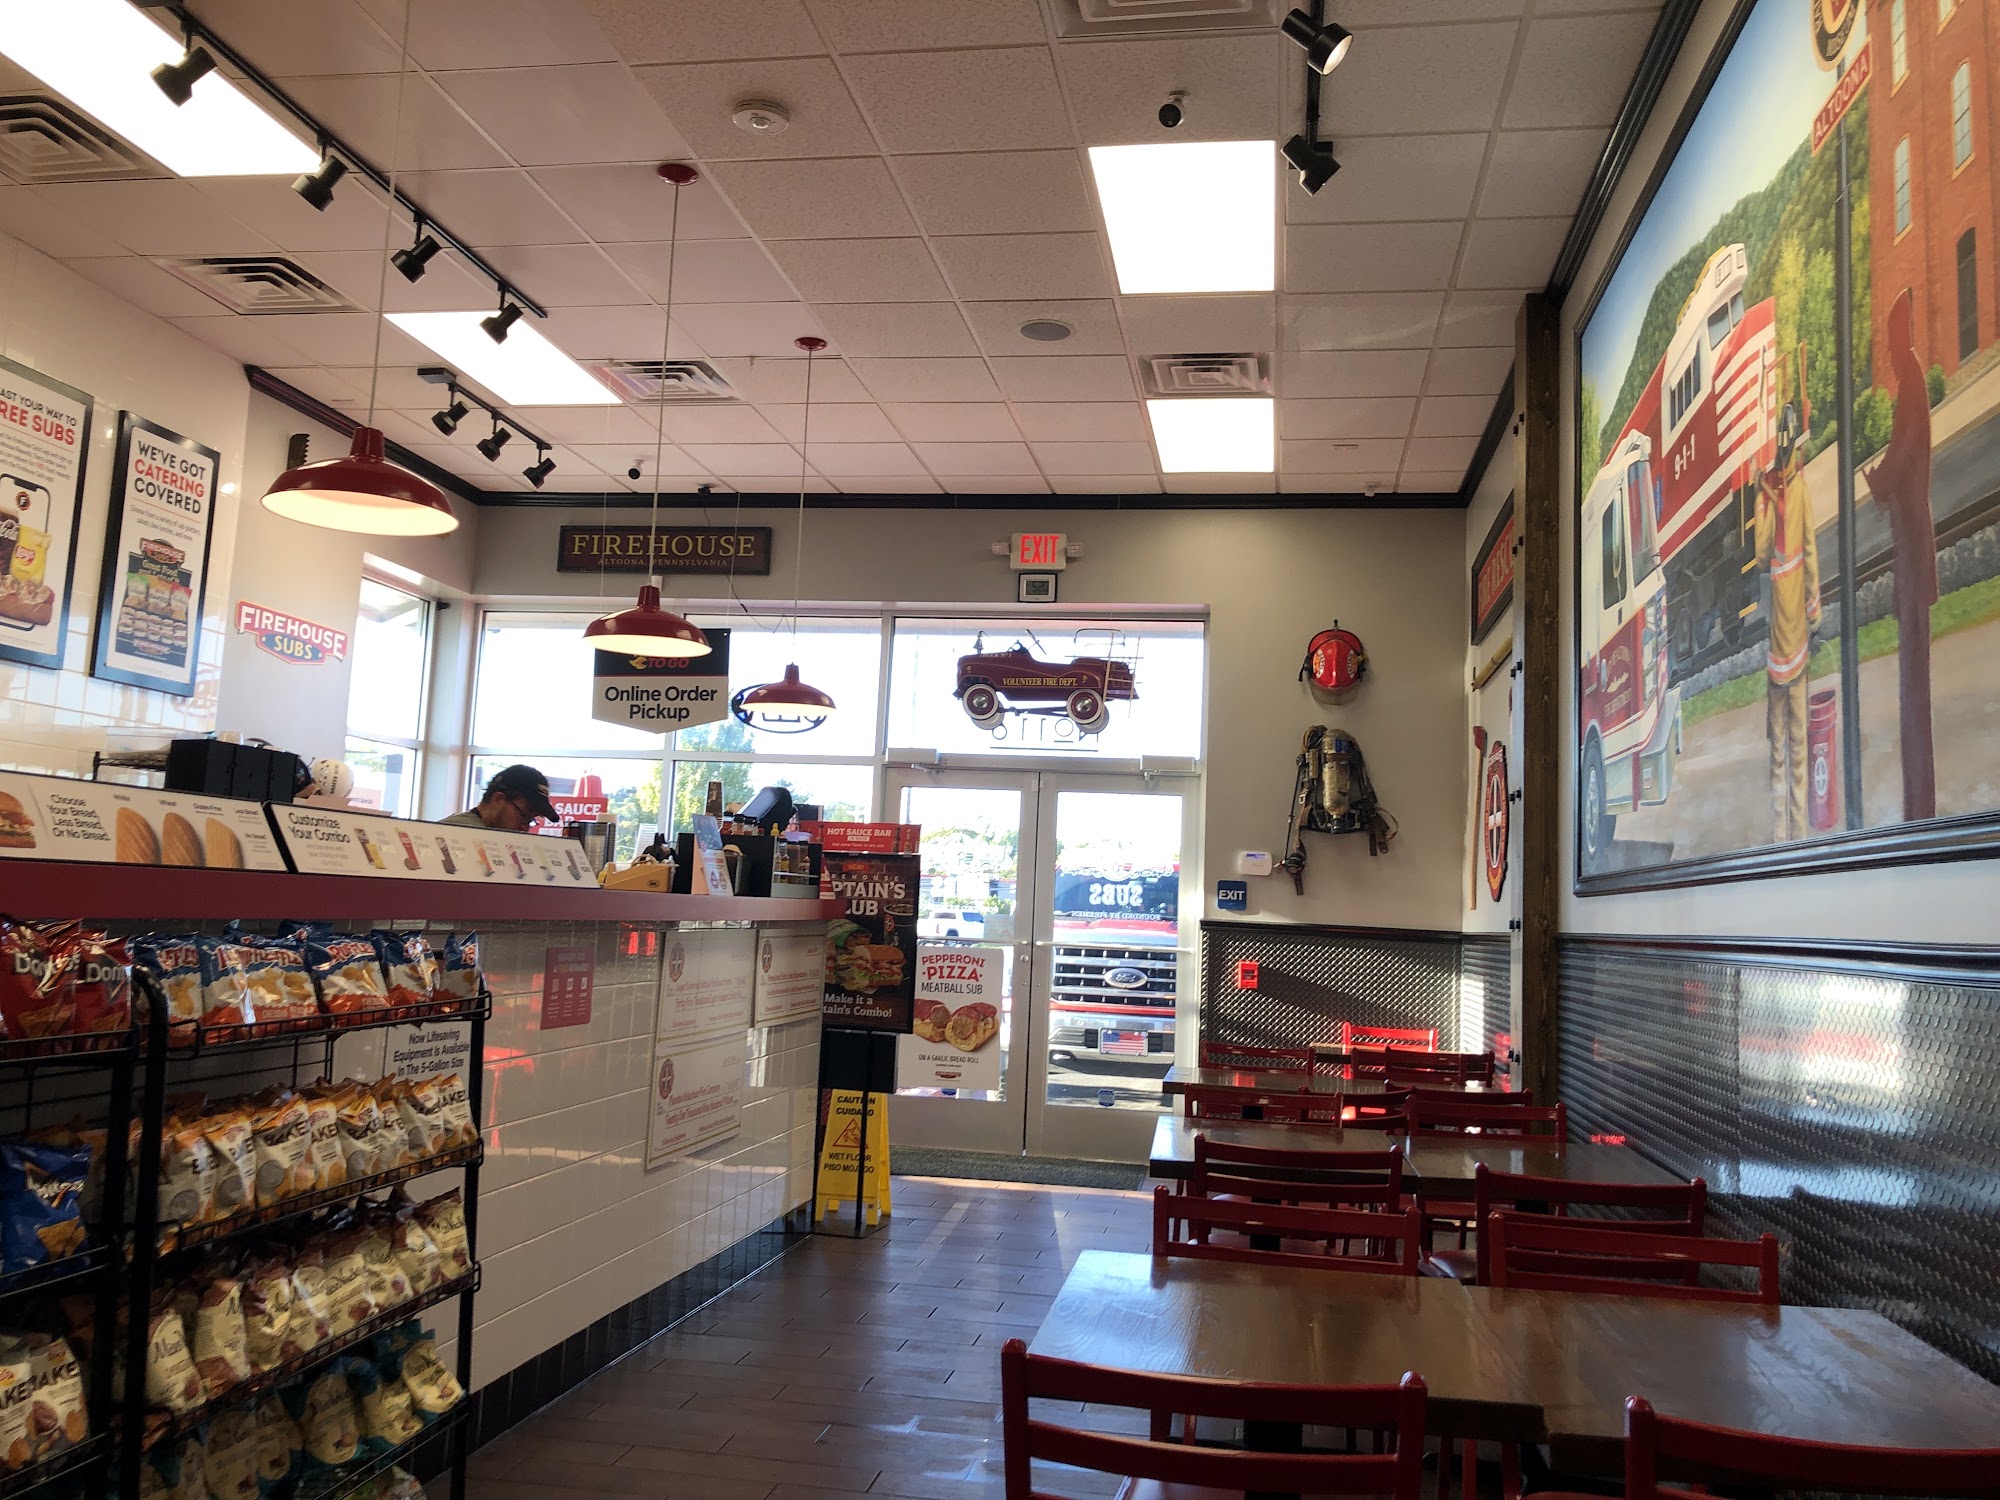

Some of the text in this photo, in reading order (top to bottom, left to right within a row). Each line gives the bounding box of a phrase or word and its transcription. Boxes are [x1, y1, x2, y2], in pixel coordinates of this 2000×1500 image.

[1815, 53, 1869, 144] ALTOONA
[0, 388, 77, 427] AST YOUR WAY TO
[0, 400, 75, 445] REE SUBS
[138, 441, 206, 480] WE'VE GOT
[1674, 433, 1696, 481] 9-1-1
[135, 459, 204, 497] CATERING
[134, 477, 201, 514] COVERED
[572, 534, 755, 557] FIREHOUSE
[1020, 535, 1060, 564] EXIT
[598, 558, 728, 567] ALTOONA, PENNSYLVANIA
[239, 605, 346, 661] FIREHOUSE
[273, 635, 313, 660] SUBS
[646, 657, 690, 668] TO GO
[1002, 677, 1042, 686] VOLUNTEER
[1043, 677, 1059, 686] FIRE
[605, 685, 719, 702] Online Order
[629, 704, 690, 722] Pickup
[51, 794, 86, 806] Choose
[555, 802, 602, 815] SAUCE
[47, 804, 68, 815] Your
[52, 816, 73, 826] Less
[288, 812, 340, 829] Customize
[53, 828, 65, 837] Or
[67, 829, 80, 838] No
[288, 825, 351, 843] Your Combo
[827, 828, 846, 836] HOT
[873, 829, 892, 837] BAR
[831, 873, 899, 882] REHOUSE
[831, 881, 906, 899] PTAIN'S
[1218, 889, 1245, 900] EXIT
[845, 899, 879, 916] UB
[922, 954, 986, 968] PEPPERONI
[926, 965, 980, 982] PIZZA
[921, 982, 983, 995] MEATBALL SUB
[824, 993, 873, 1005] Make it a
[823, 1004, 892, 1018] tain's Combo!
[409, 1029, 460, 1045] Now Lifesaving
[393, 1047, 433, 1063] Equipment
[441, 1042, 470, 1055] Available
[406, 1063, 419, 1075] The
[421, 1060, 450, 1073] 5-Gallon
[451, 1057, 464, 1068] Size
[836, 1106, 875, 1117] CUIDAO
[828, 1152, 872, 1162] WET FLOR
[824, 1162, 841, 1171] PISO
[39, 1360, 81, 1386] AKE
